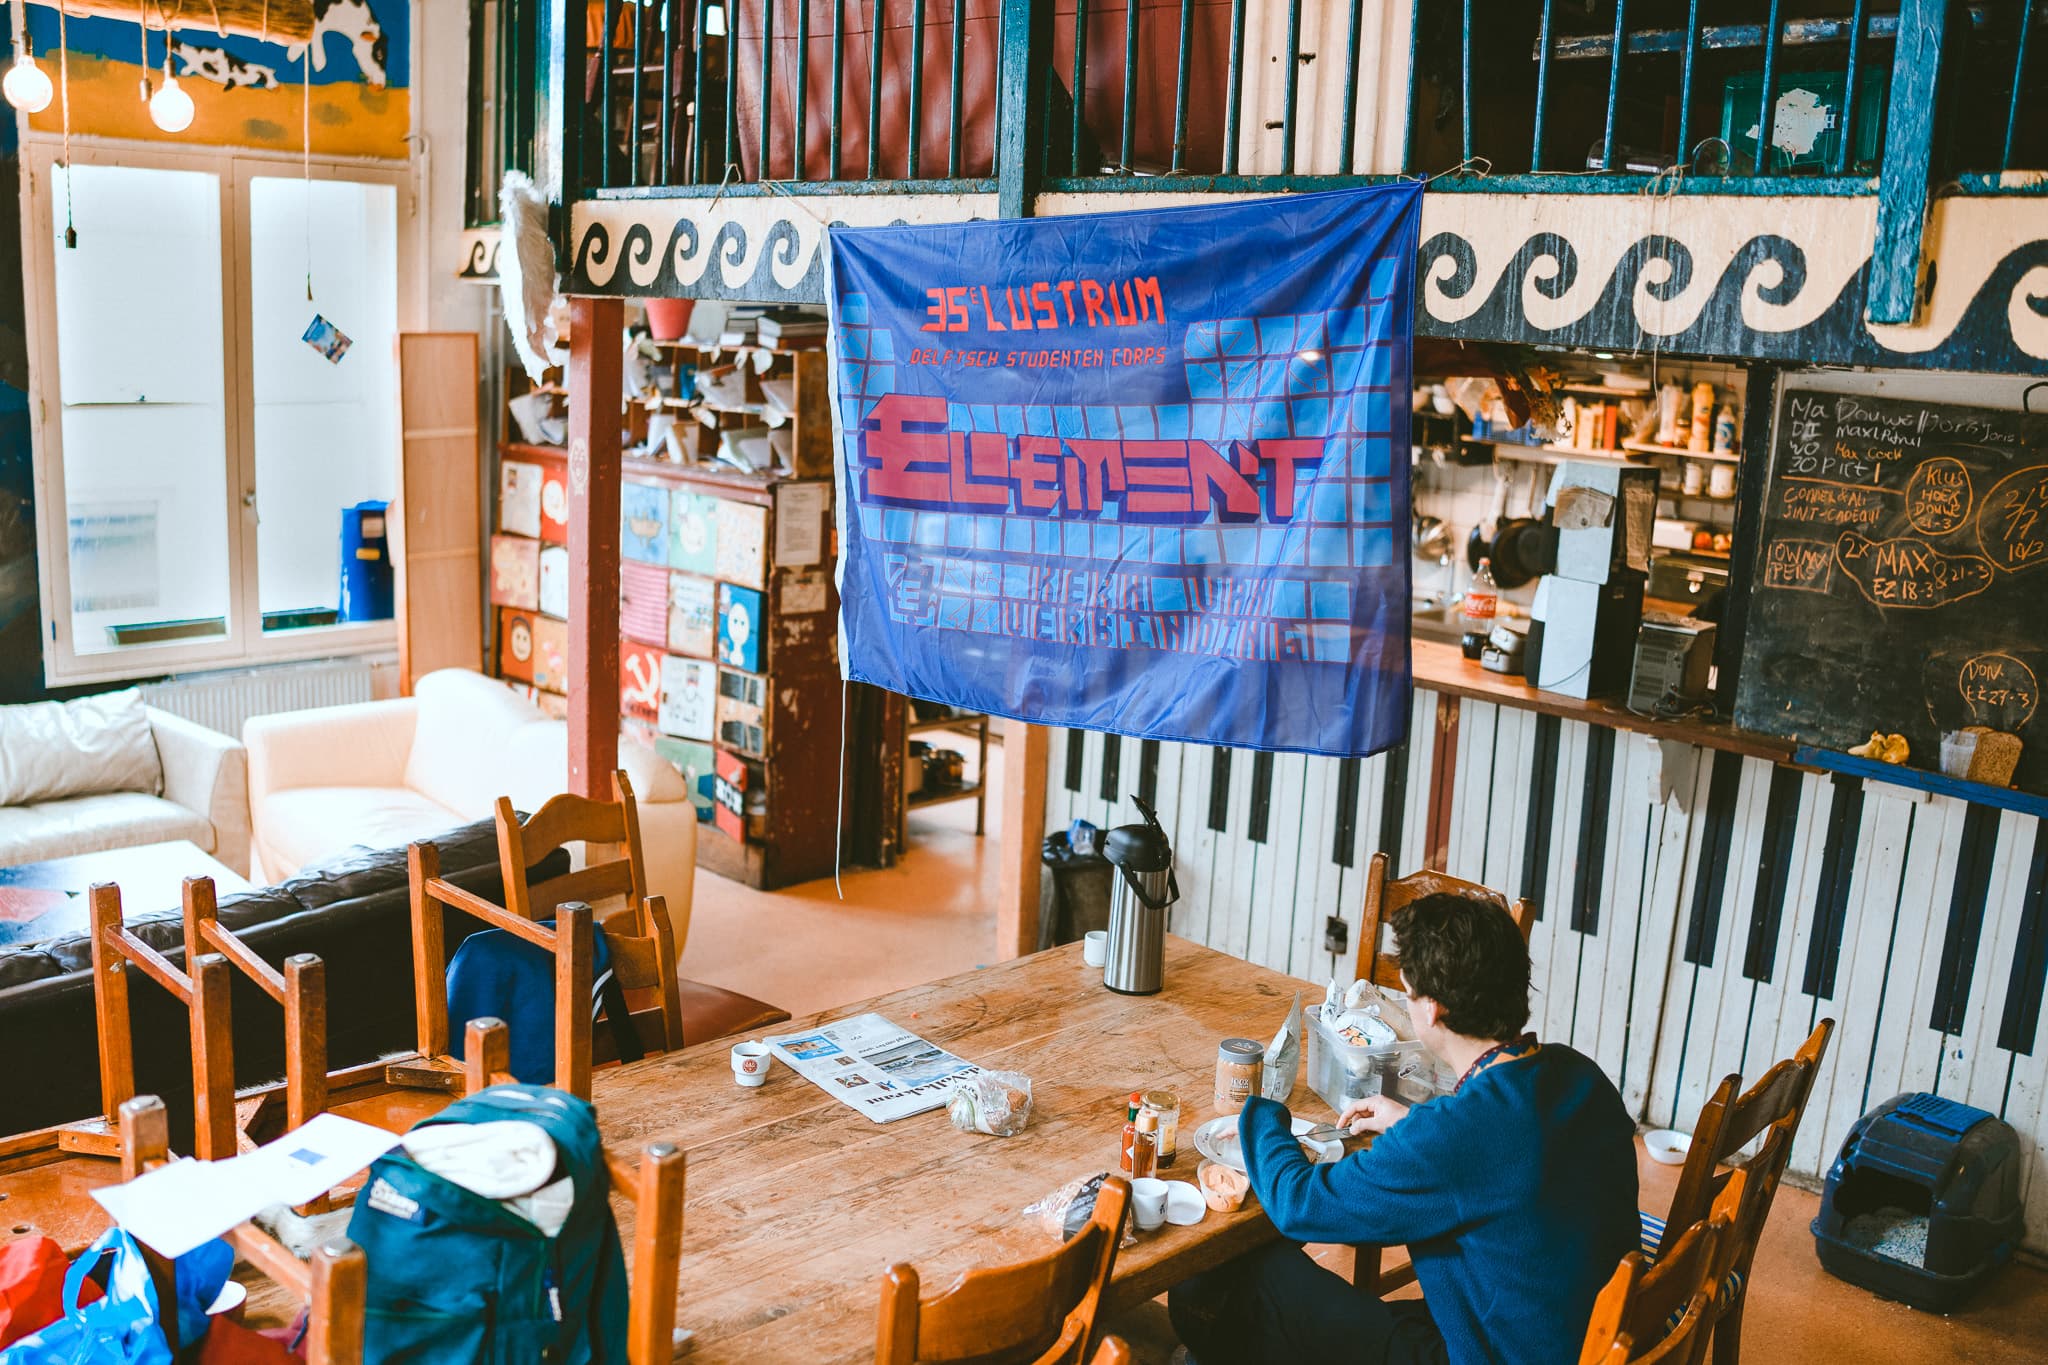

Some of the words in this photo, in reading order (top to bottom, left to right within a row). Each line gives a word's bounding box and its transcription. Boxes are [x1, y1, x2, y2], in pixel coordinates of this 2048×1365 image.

[980, 276, 1166, 332] LUSTRUM
[910, 348, 999, 367] DELFTSCH
[1005, 349, 1103, 369] STUDENTEN
[1111, 346, 1167, 366] CORPS
[859, 392, 1325, 524] ELEMENT
[1875, 543, 1930, 578] MAX
